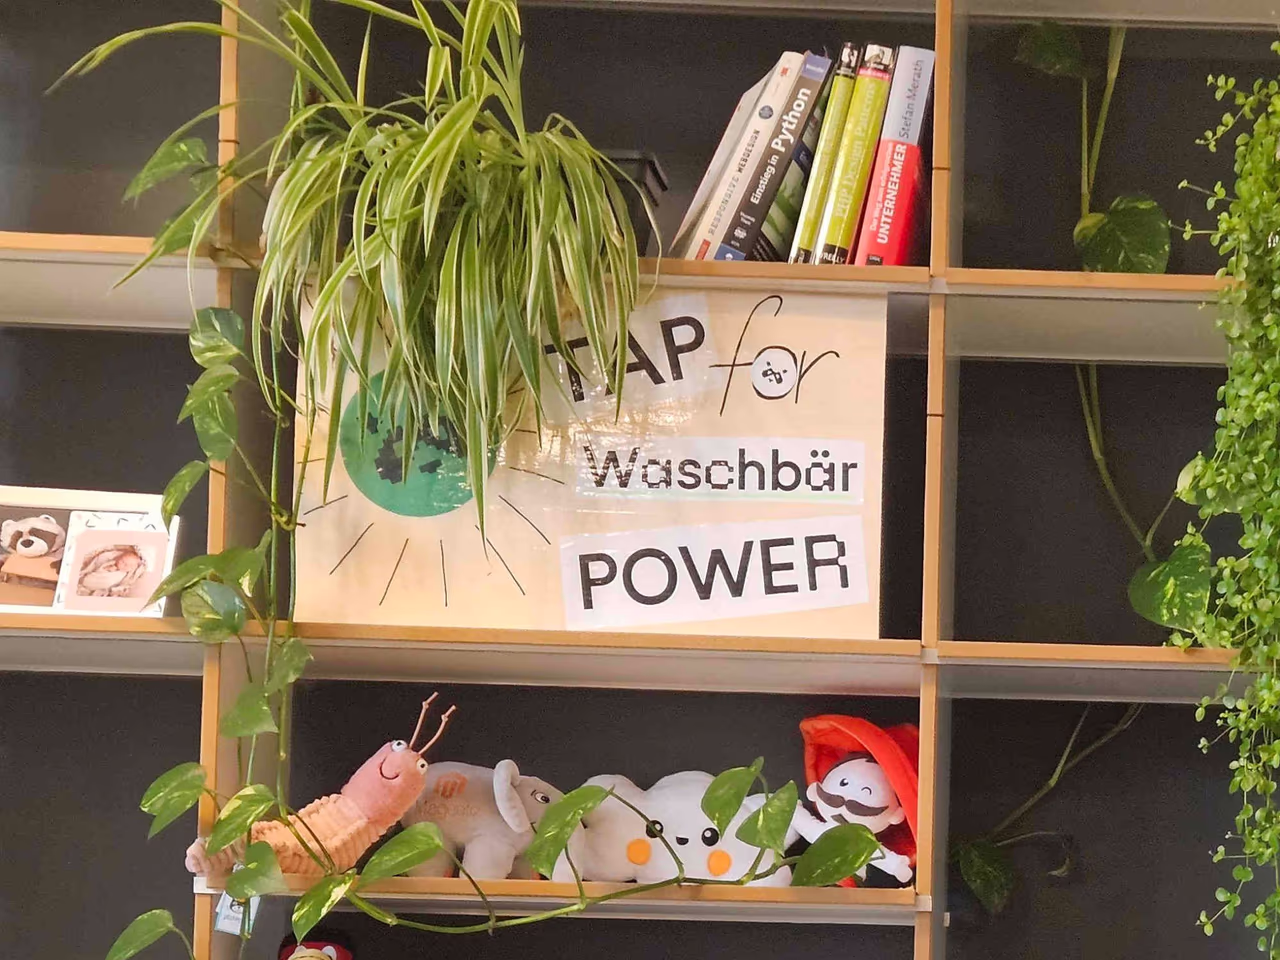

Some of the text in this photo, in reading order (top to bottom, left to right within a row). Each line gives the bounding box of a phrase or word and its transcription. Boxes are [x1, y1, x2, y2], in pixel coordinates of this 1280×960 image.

[899, 59, 925, 140] Stefan Merath
[737, 129, 761, 174] WEBDESIGN
[750, 165, 776, 205] Einstieg
[771, 87, 812, 154] Python
[877, 144, 907, 245] UNTERNEHMER
[544, 295, 840, 416] TAP for
[582, 446, 858, 493] Waschbär
[578, 533, 848, 610] POWER
